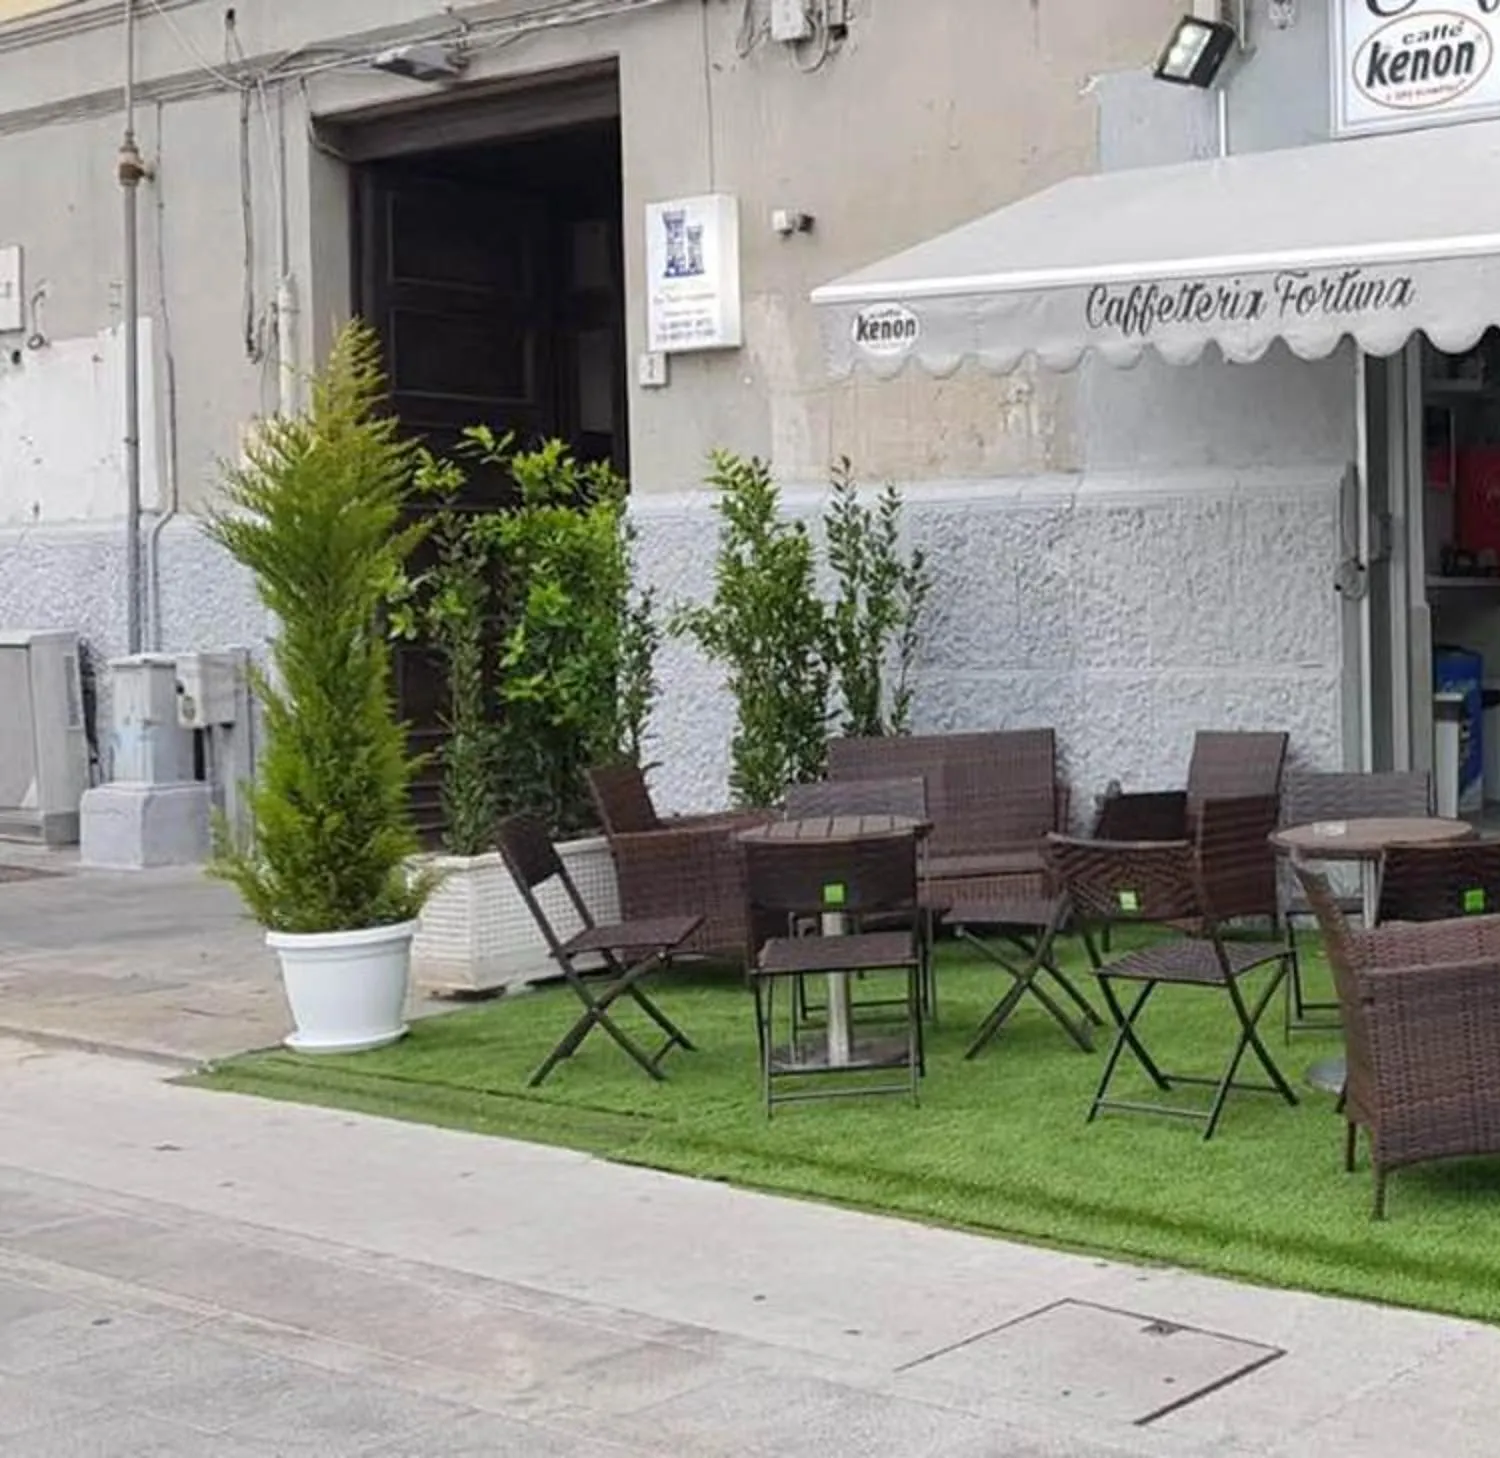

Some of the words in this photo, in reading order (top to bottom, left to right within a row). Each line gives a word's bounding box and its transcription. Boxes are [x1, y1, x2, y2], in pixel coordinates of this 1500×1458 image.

[1366, 41, 1475, 87] kenon
[1086, 279, 1267, 336] Caffetteria
[1275, 269, 1416, 317] Fortuna
[856, 314, 916, 342] kenon
